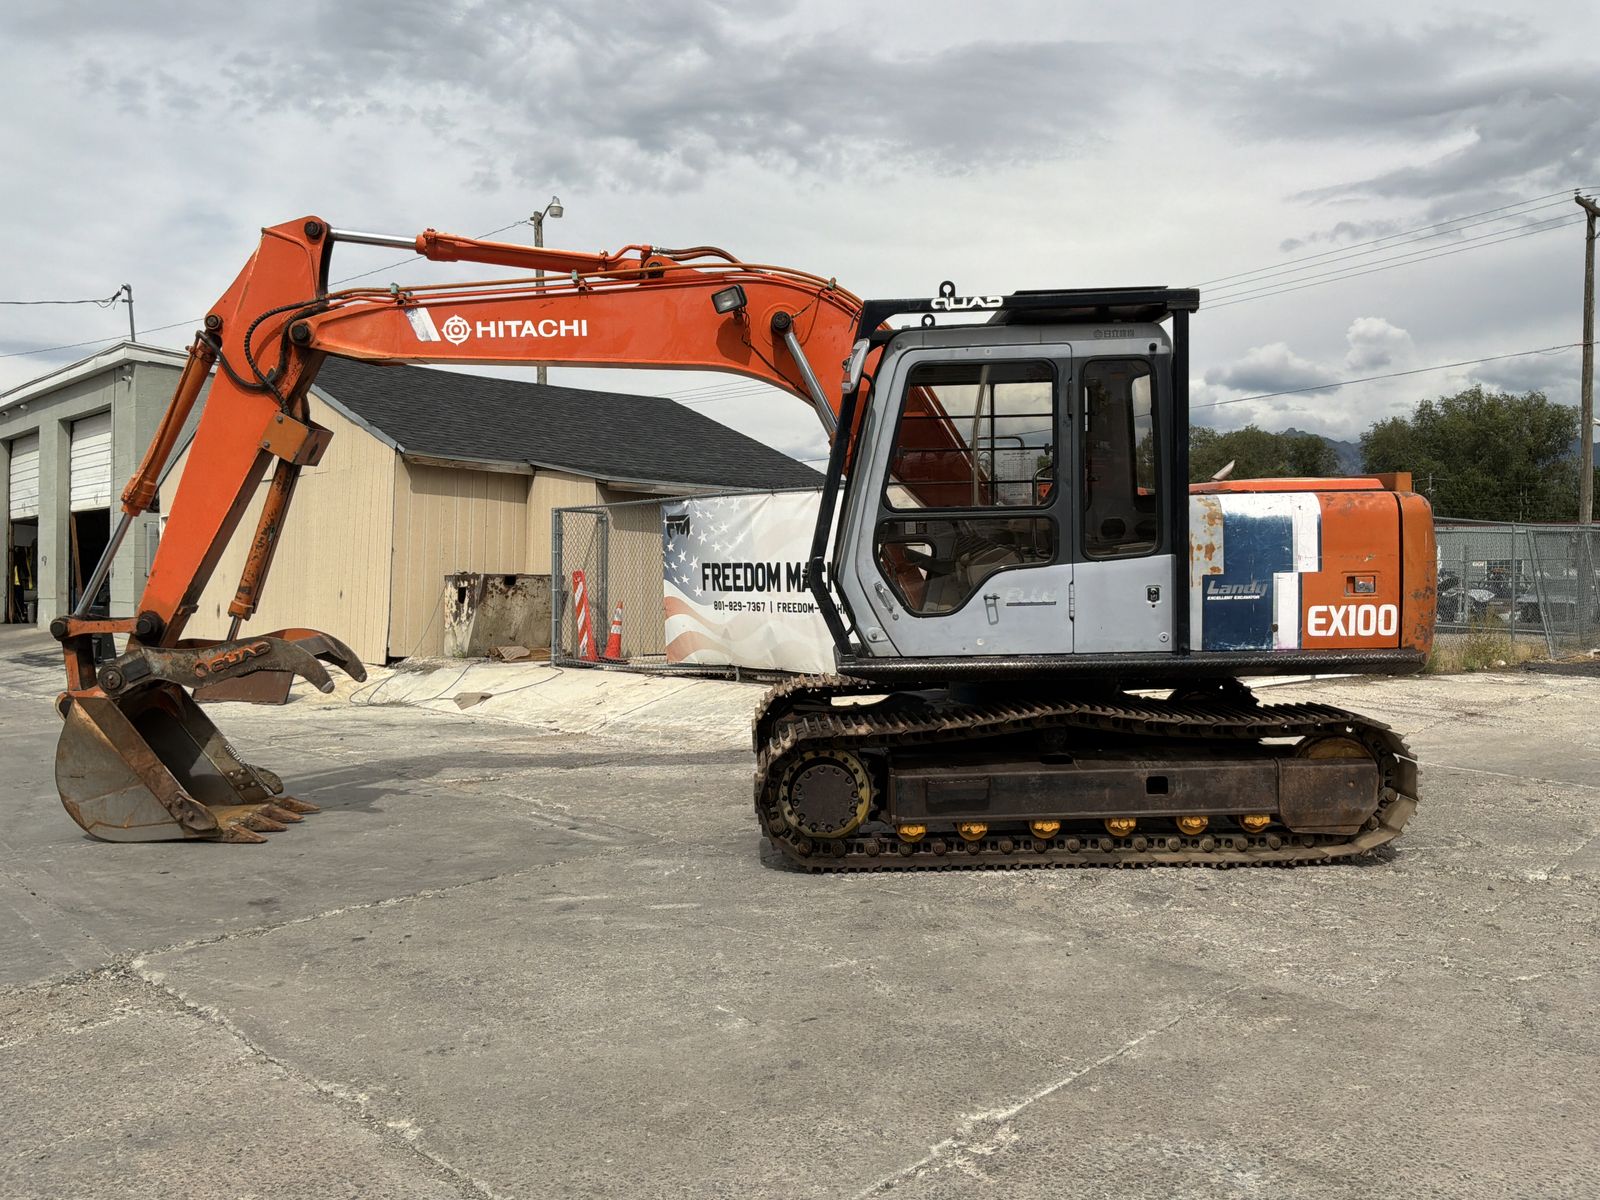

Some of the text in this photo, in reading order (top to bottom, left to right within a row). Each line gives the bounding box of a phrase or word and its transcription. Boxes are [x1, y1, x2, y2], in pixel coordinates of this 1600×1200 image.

[476, 319, 588, 338] HITACHI
[702, 562, 781, 592] FREEDOM
[1207, 580, 1268, 597] Landy
[714, 601, 766, 612] 801-829-7367
[1307, 603, 1398, 637] EX100
